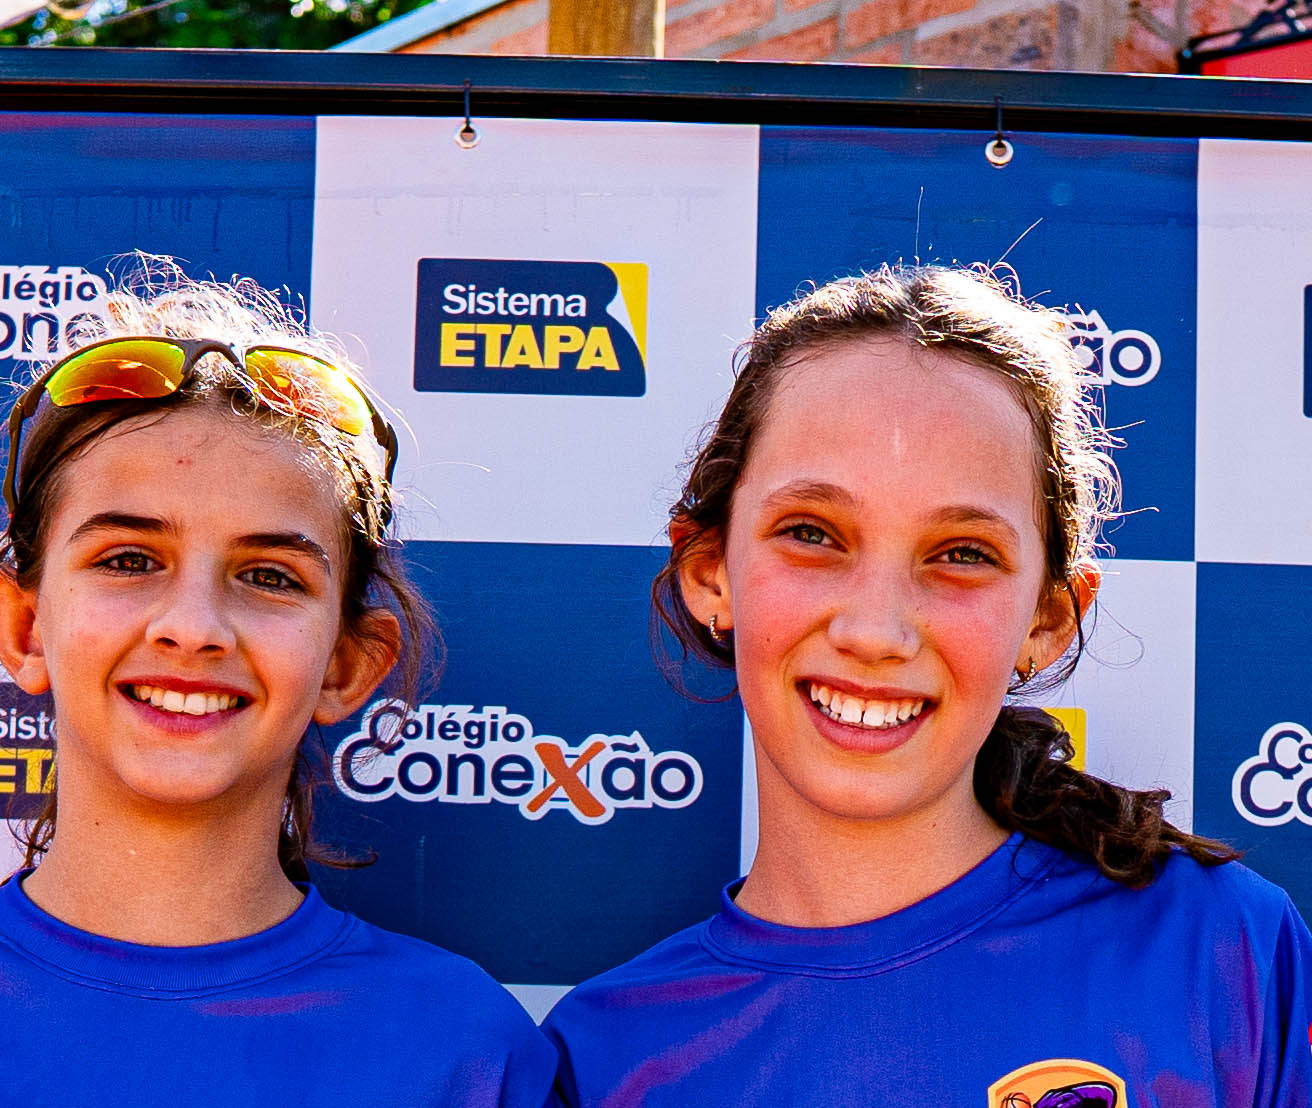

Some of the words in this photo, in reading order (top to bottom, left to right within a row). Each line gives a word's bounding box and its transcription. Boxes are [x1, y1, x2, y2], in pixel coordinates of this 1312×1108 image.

[443, 284, 586, 319] Sistema
[439, 323, 620, 372] ETAPA
[368, 706, 523, 750] Colégio
